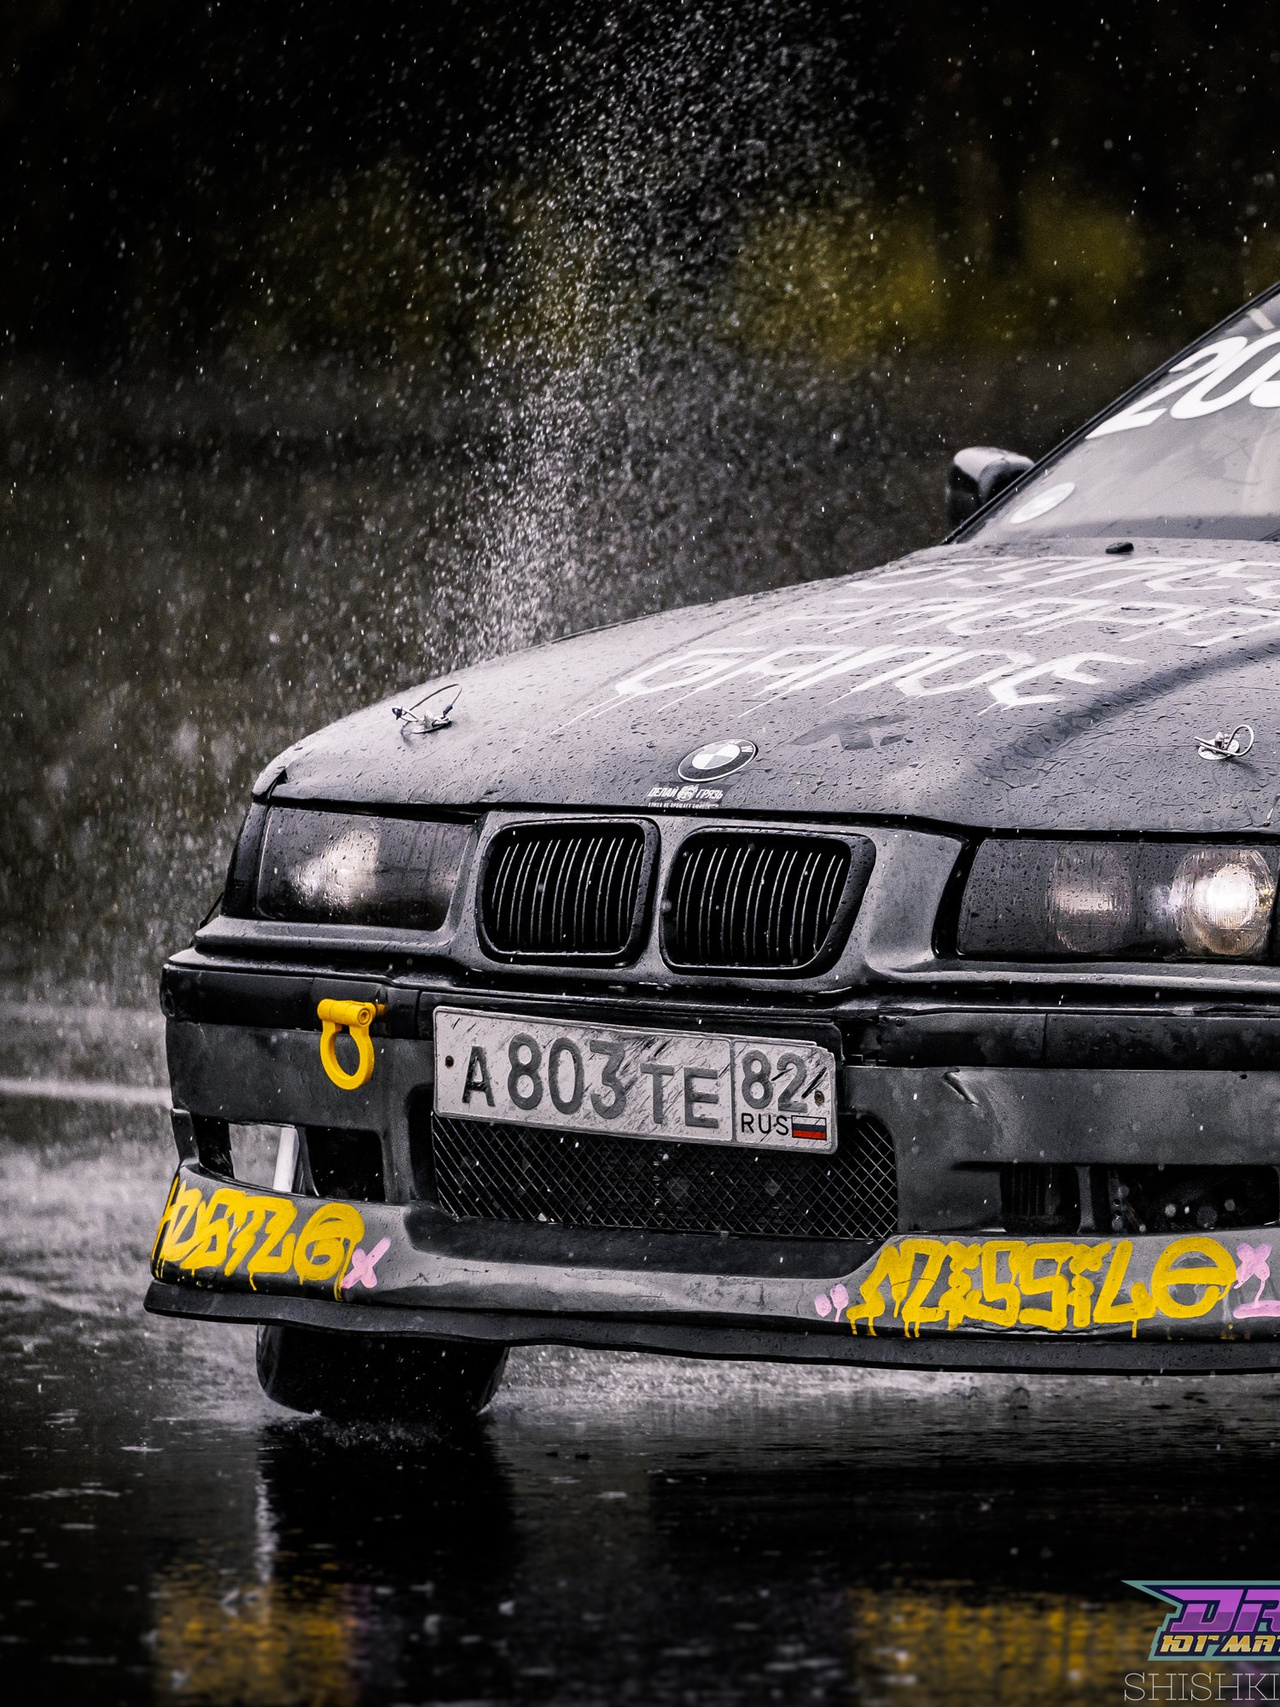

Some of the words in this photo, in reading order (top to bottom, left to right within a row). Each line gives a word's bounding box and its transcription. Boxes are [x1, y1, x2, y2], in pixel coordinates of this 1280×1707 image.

[647, 786, 679, 798] ДЕЛАЙ
[695, 788, 724, 800] ГРЯЗЬ
[741, 1048, 809, 1113] 82
[740, 1111, 790, 1136] RUS
